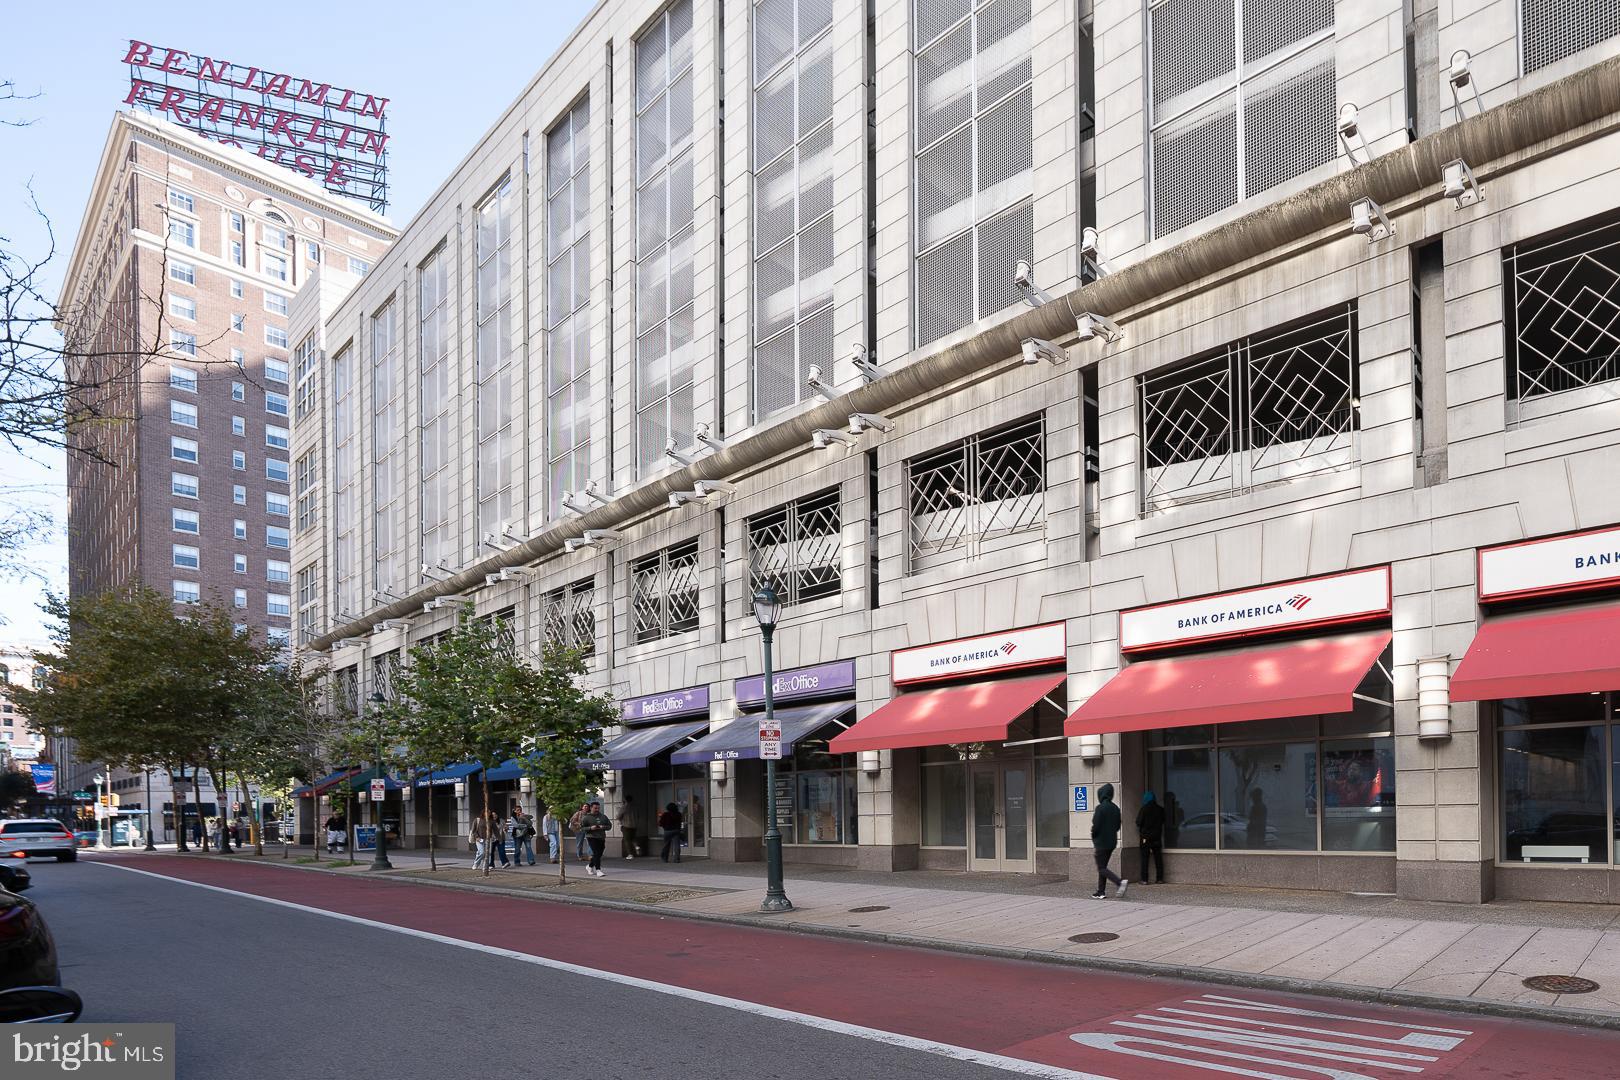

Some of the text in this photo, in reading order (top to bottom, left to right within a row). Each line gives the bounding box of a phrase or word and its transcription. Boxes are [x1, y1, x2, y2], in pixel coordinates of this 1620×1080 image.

[121, 39, 390, 119] BENJAMIN
[121, 79, 390, 157] FRANKLIN
[217, 138, 352, 187] USE
[1178, 604, 1283, 629] BANK OF AMERICA
[930, 649, 999, 667] BANK OF AMERICA
